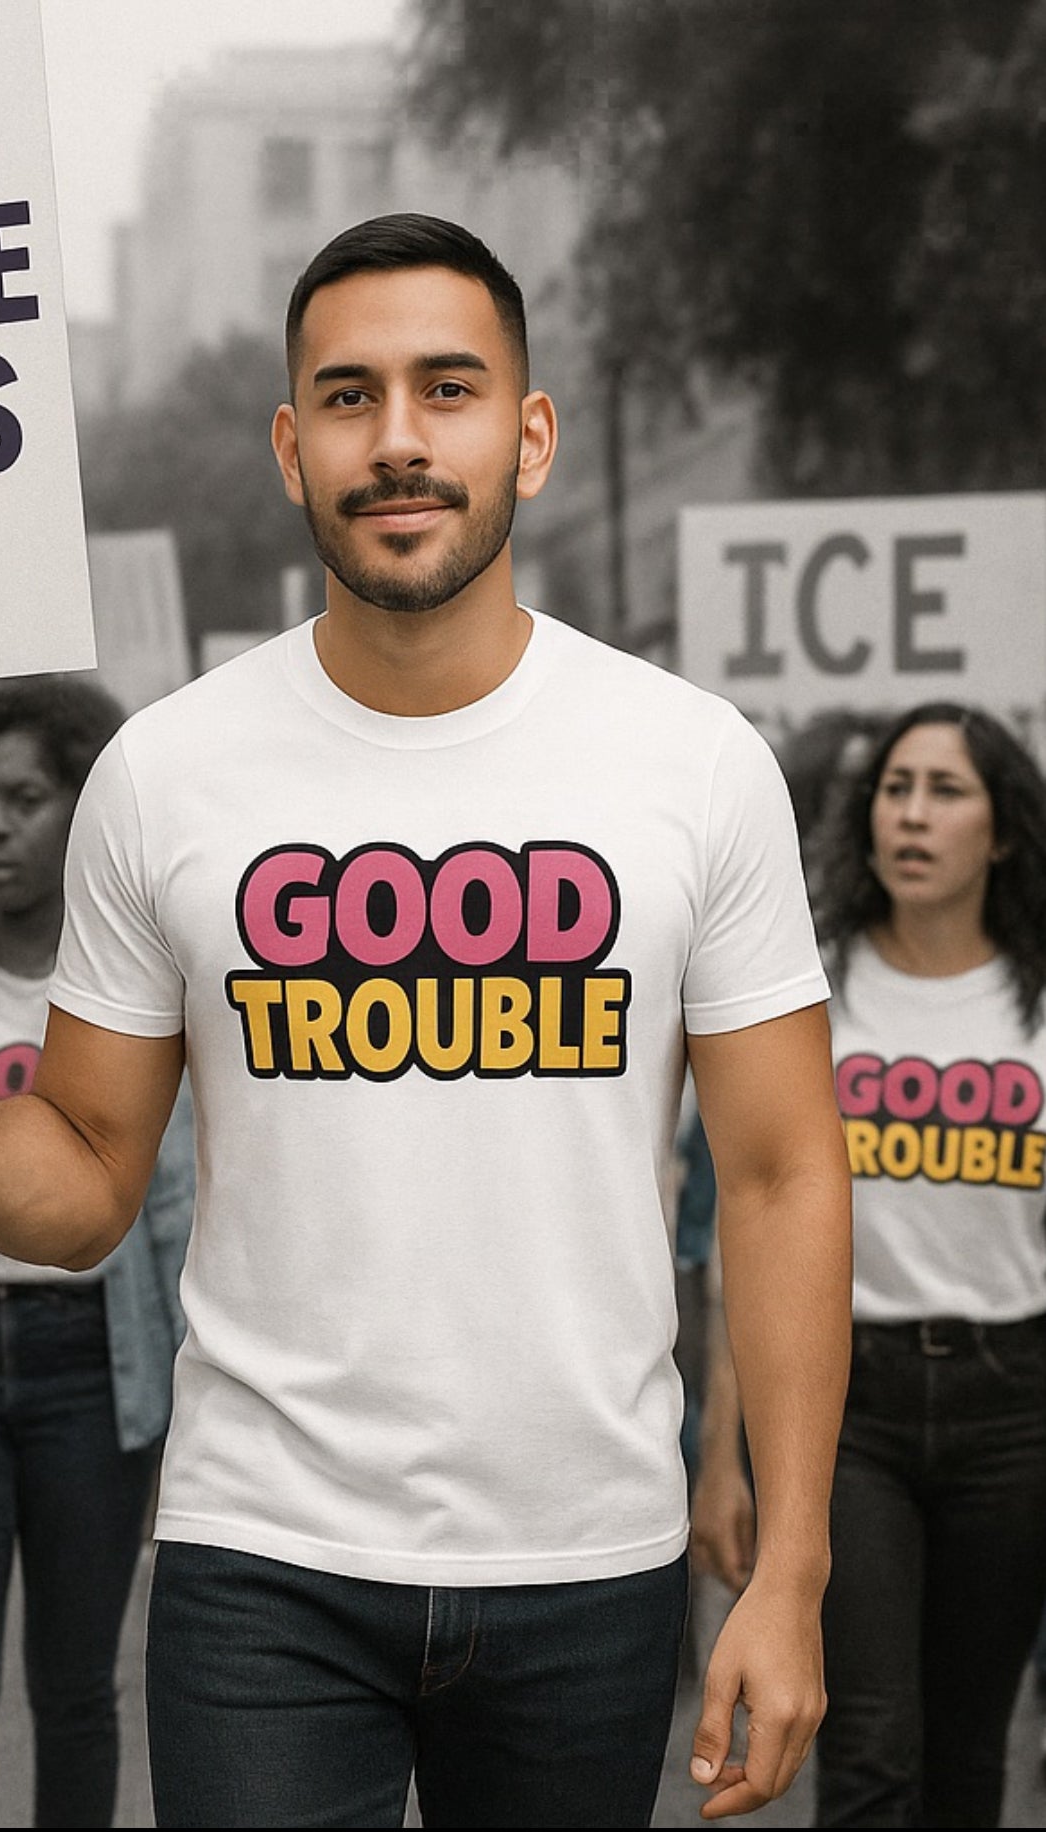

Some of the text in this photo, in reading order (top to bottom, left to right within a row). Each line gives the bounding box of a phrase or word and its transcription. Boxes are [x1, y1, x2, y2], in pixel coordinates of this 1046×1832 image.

[722, 531, 967, 681] ICE
[242, 848, 613, 968] GOOD
[230, 976, 625, 1073] TROUBLE
[835, 1054, 1044, 1126] GOOD
[842, 1118, 1046, 1188] ROUBLE
